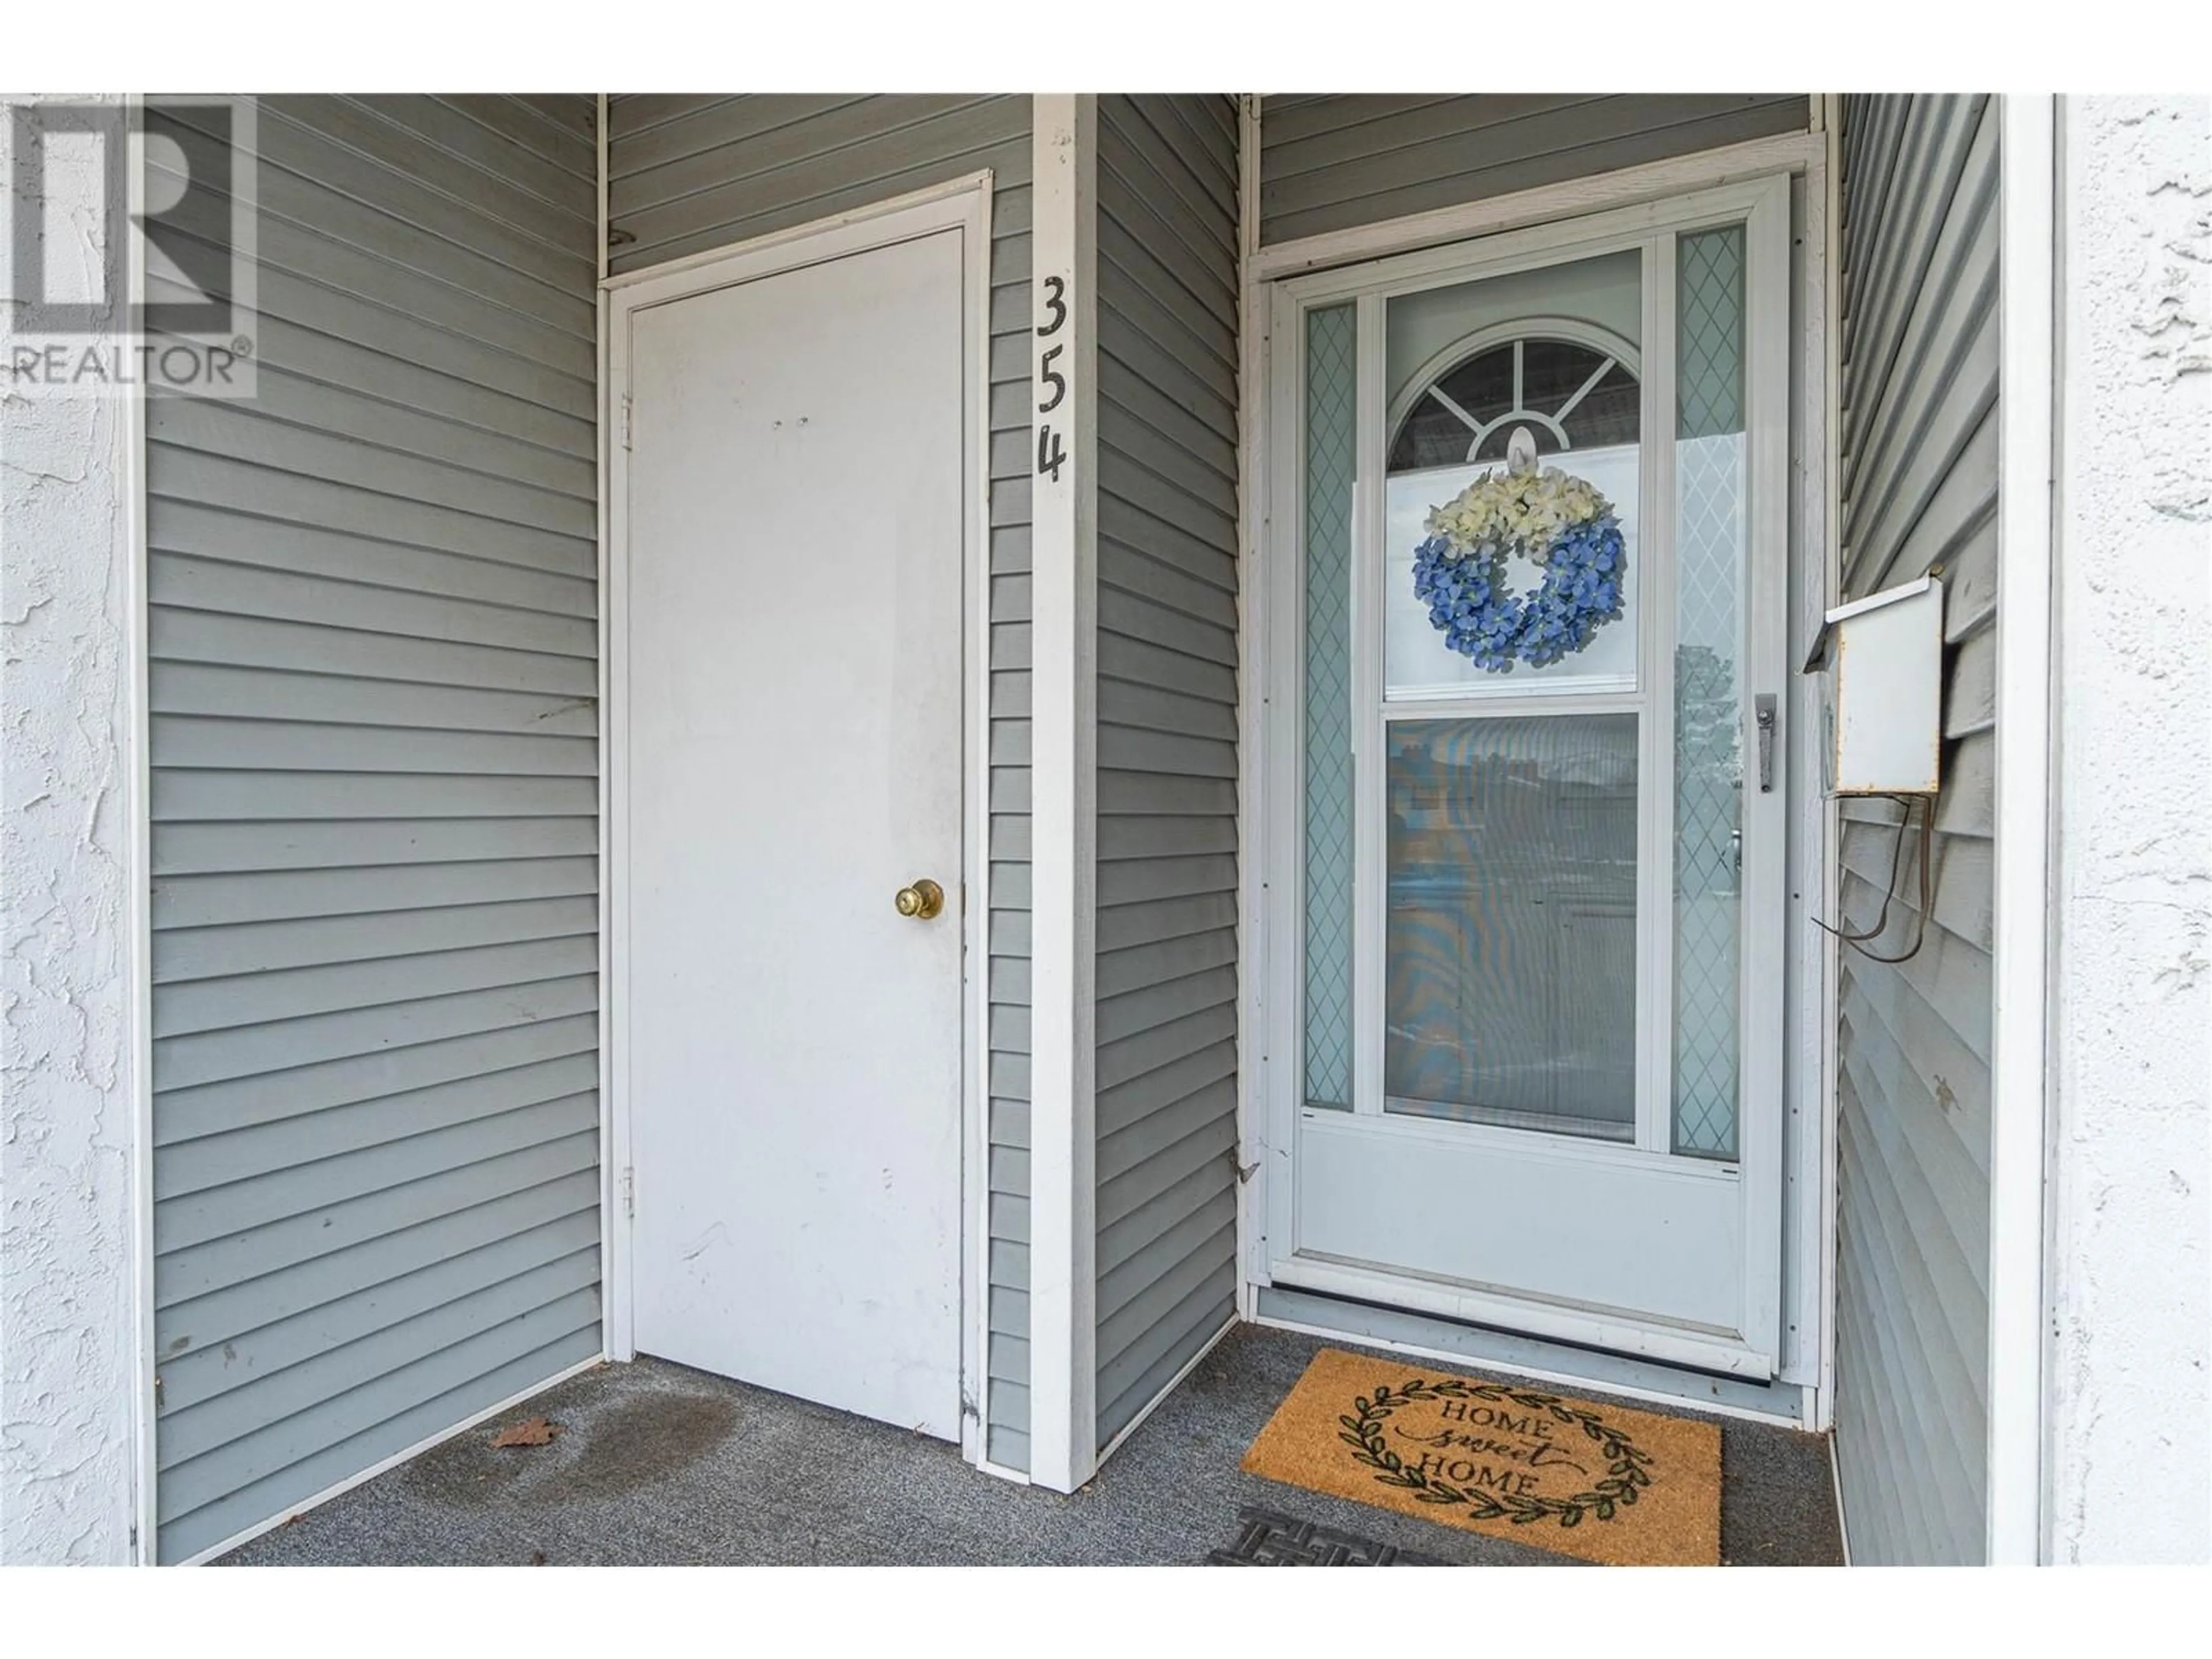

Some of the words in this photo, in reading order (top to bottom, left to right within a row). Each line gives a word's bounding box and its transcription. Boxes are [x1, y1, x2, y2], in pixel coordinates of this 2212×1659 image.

[1037, 276, 1067, 482] 354
[1441, 1400, 1554, 1440] HOME
[1395, 1426, 1588, 1475] sweet
[1415, 1453, 1539, 1498] HOME
